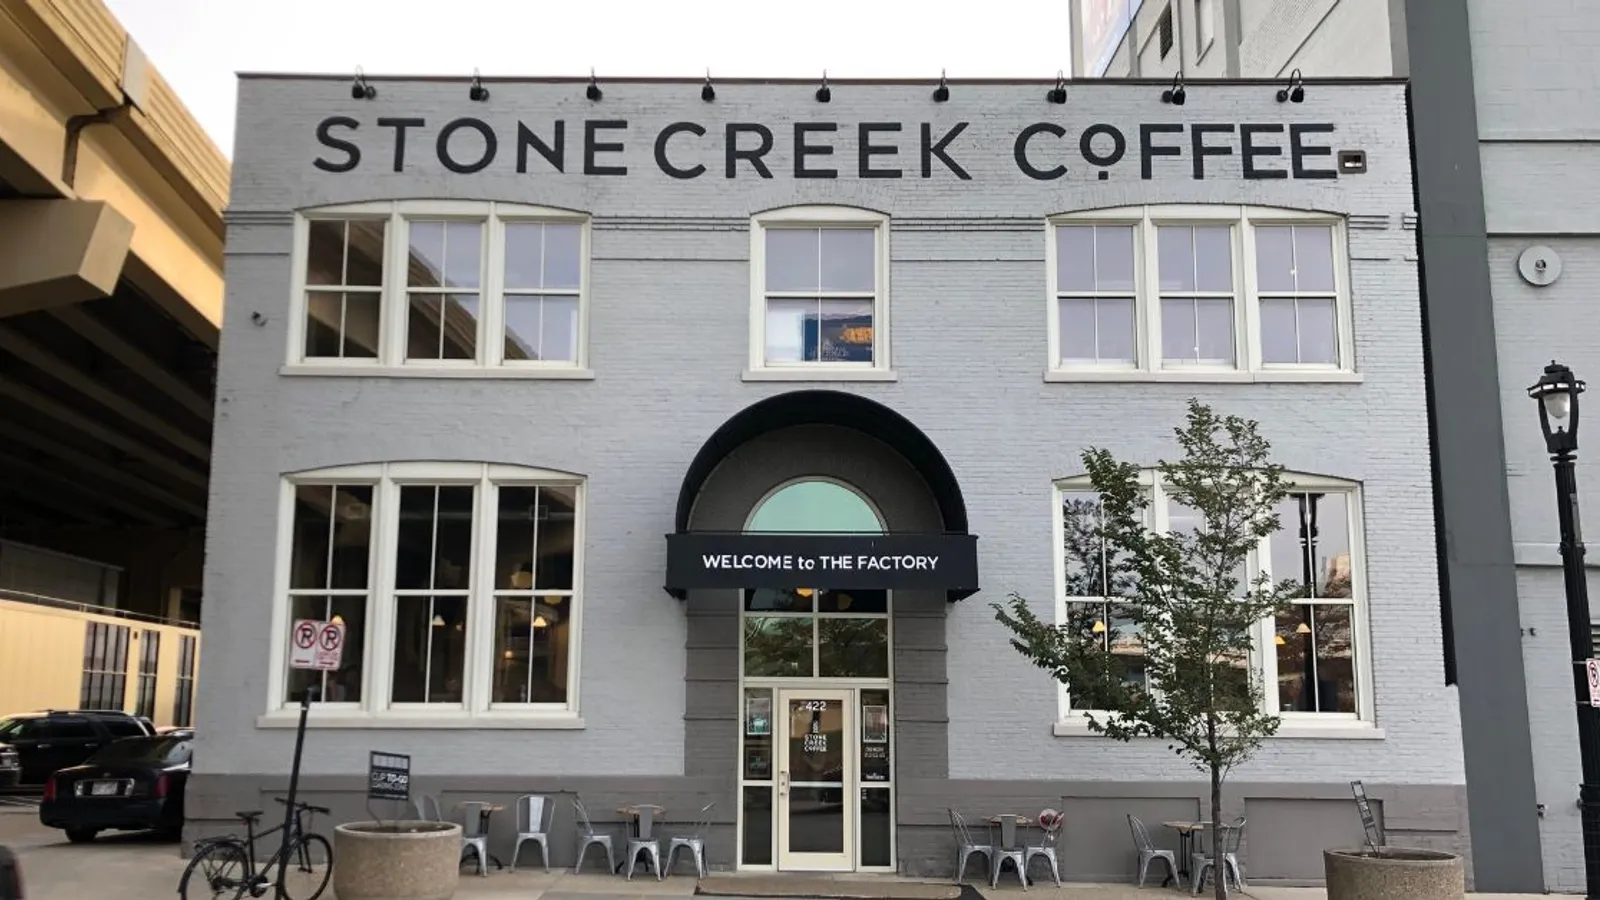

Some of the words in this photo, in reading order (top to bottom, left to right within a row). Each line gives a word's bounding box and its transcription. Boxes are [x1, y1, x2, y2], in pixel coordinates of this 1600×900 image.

[702, 554, 793, 570] WELCOME
[797, 556, 816, 571] to
[818, 555, 853, 570] THE
[857, 554, 939, 571] FACTORY
[805, 700, 827, 711] 422
